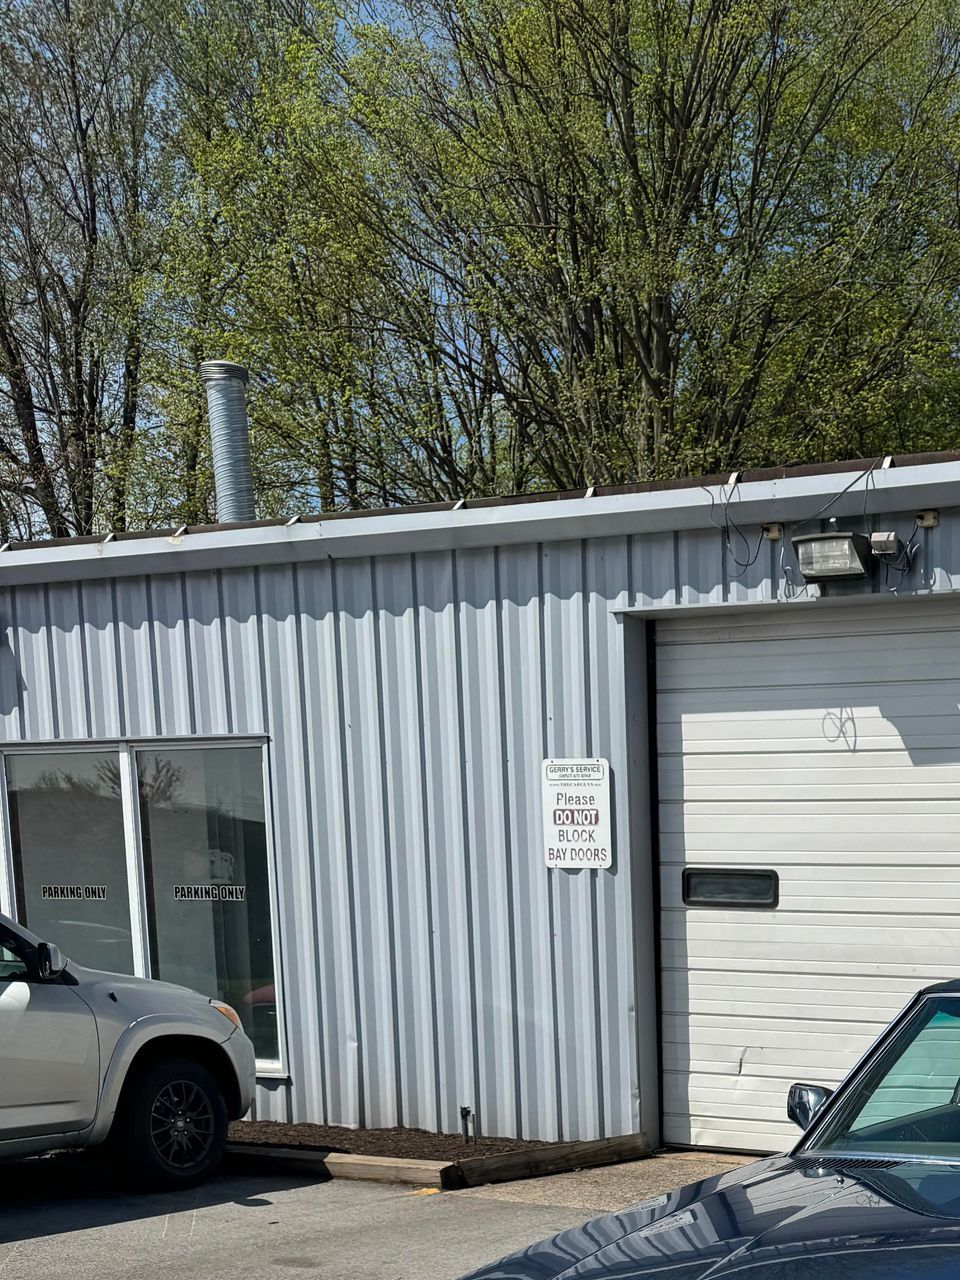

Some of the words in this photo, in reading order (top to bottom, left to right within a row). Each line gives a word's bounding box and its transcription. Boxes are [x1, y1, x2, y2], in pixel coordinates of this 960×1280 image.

[556, 792, 595, 806] Please
[555, 809, 572, 825] DO
[573, 809, 597, 825] NOT
[558, 829, 596, 843] BLOCK
[548, 848, 567, 861] BAY
[571, 848, 607, 862] DOORS
[41, 885, 82, 899] PARKING
[84, 886, 107, 899] ONLY
[174, 885, 218, 900] PARKING
[219, 886, 245, 900] ONLY
